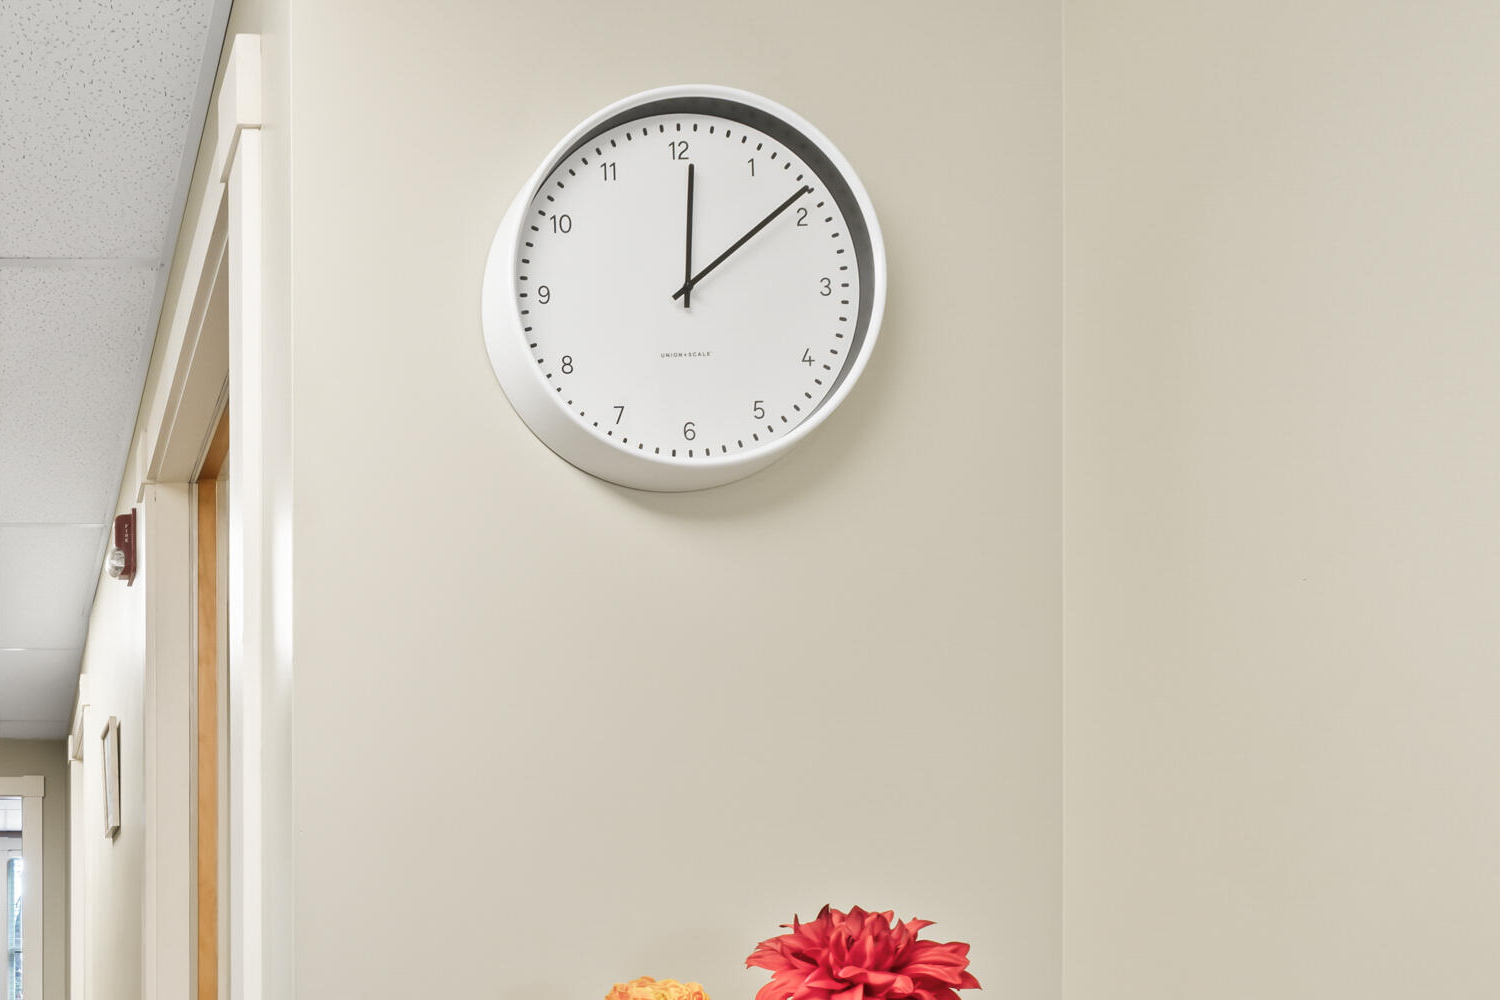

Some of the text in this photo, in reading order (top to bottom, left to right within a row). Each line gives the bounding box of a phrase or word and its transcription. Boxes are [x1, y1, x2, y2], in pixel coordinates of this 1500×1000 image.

[668, 140, 690, 161] 12
[600, 162, 617, 182] 11
[747, 157, 756, 177] 1
[549, 214, 573, 234] 10
[796, 207, 809, 227] 2
[537, 284, 551, 305] 9
[819, 276, 832, 297] 3
[561, 354, 574, 375] 8
[801, 347, 816, 367] 4
[613, 405, 625, 425] 7
[753, 400, 766, 420] 5
[683, 421, 696, 441] 6
